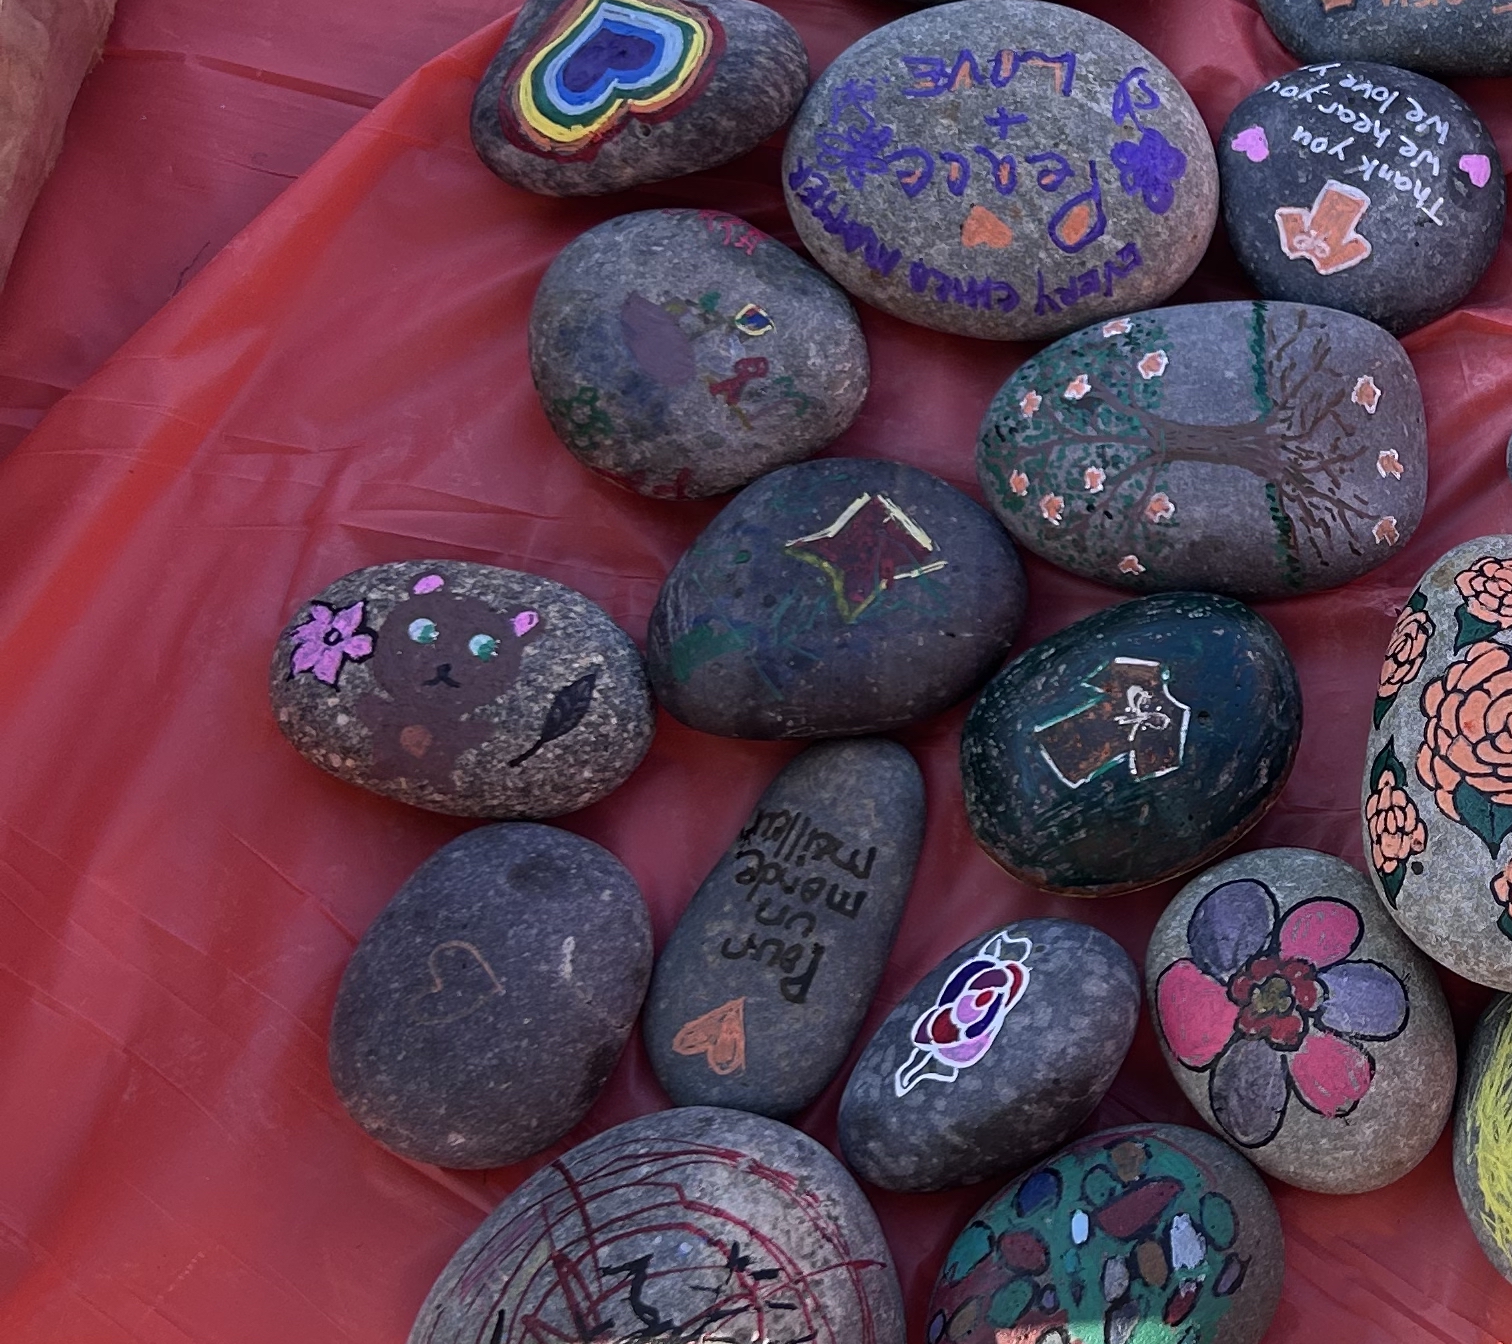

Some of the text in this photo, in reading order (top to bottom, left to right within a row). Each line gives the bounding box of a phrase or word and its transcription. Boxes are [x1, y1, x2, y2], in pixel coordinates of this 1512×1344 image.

[900, 50, 1075, 96] LOVE
[1338, 74, 1398, 112] love
[1317, 102, 1390, 147] hear
[887, 146, 1105, 252] Peace
[1358, 155, 1443, 225] Thank
[734, 848, 867, 918] monde
